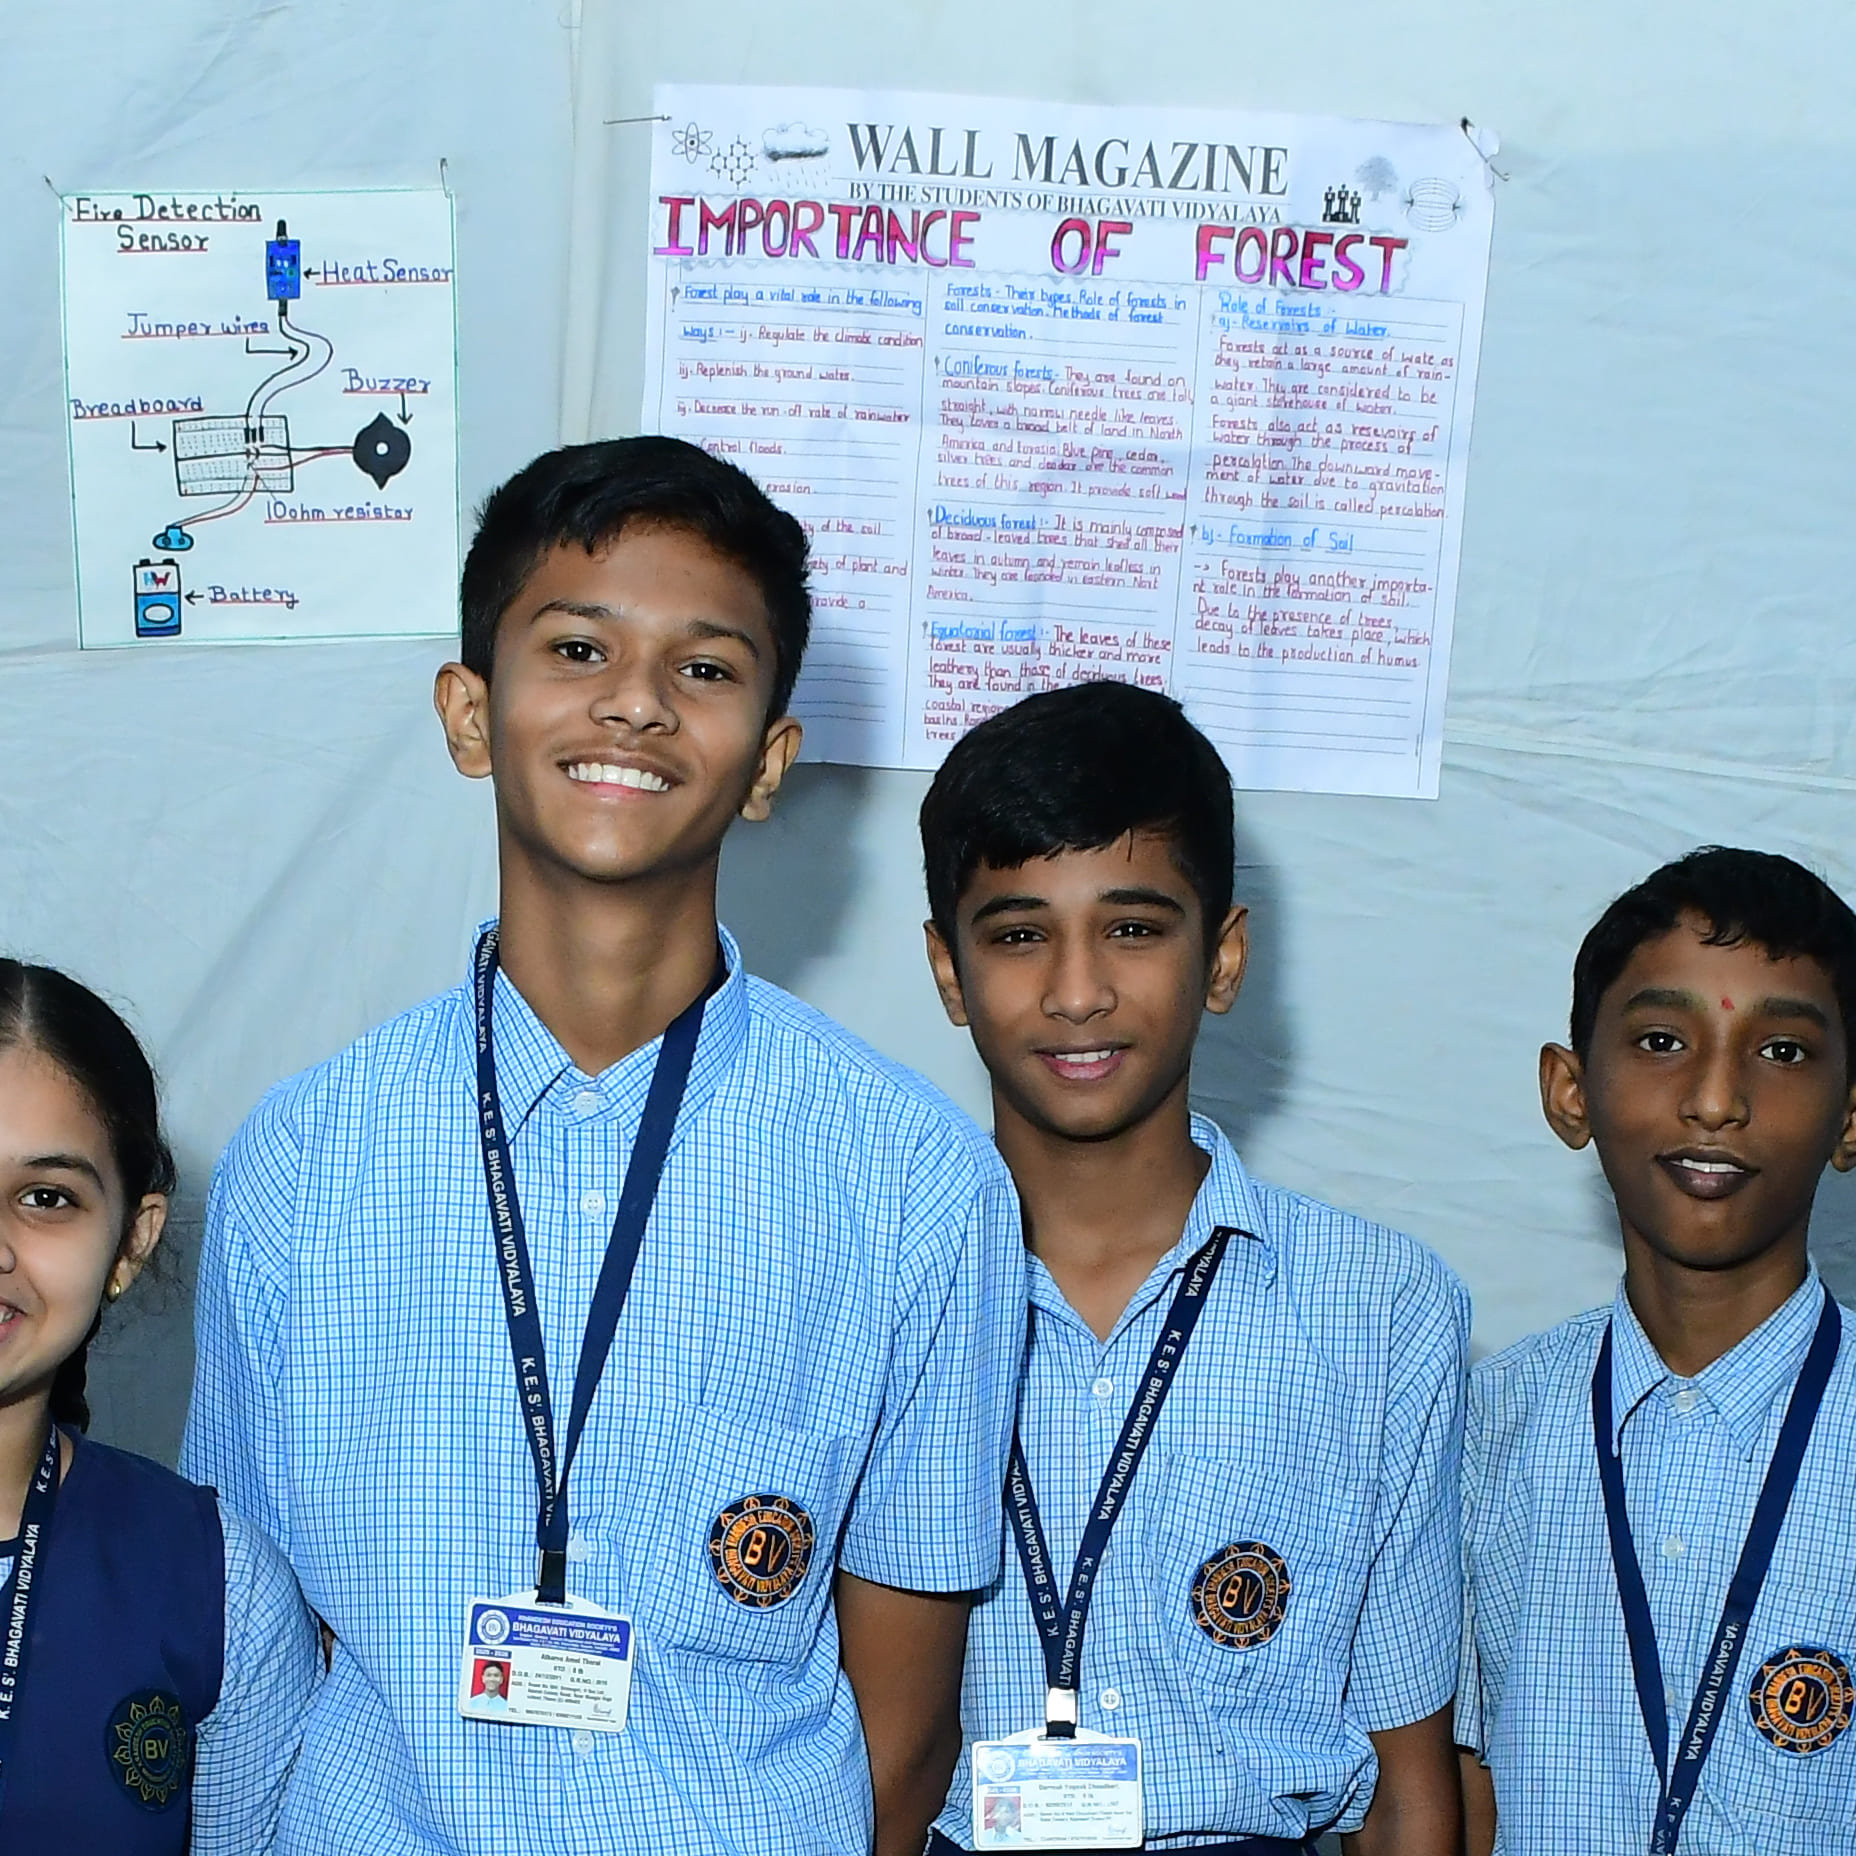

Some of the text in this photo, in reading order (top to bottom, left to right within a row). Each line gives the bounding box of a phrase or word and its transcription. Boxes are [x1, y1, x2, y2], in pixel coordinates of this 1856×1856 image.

[846, 123, 1289, 196] WALL MAGAZINE
[73, 194, 262, 221] Fire Detection
[850, 182, 1281, 224] BY THE STUDENTS OF BHAGAVATI VIDYALAYA
[116, 225, 209, 251] Sensor
[653, 196, 1409, 294] IMPORTANCE OF FOREST
[322, 257, 452, 282] Heat Sensor
[723, 286, 748, 306] play
[755, 291, 764, 301] a
[770, 288, 794, 301] vital
[846, 288, 864, 305] the
[126, 313, 269, 336] Jumper wires
[944, 356, 1008, 376] Coniferous
[343, 368, 431, 392] Buzzer
[71, 397, 204, 417] Breadboard
[333, 504, 413, 521] resistor
[935, 505, 996, 526] Deciduous
[1229, 524, 1354, 551] Formation of Soil
[209, 586, 299, 609] Battery
[1198, 637, 1418, 668] leads to the production of humus
[488, 1149, 526, 1317] BHAGAVATI VIDYALAYA
[1099, 1376, 1162, 1520] BHAGAVATI VIDYALAYA
[744, 1529, 787, 1573] BV
[513, 1621, 567, 1637] BHAGAVATI
[569, 1627, 621, 1643] VIDYALAYA
